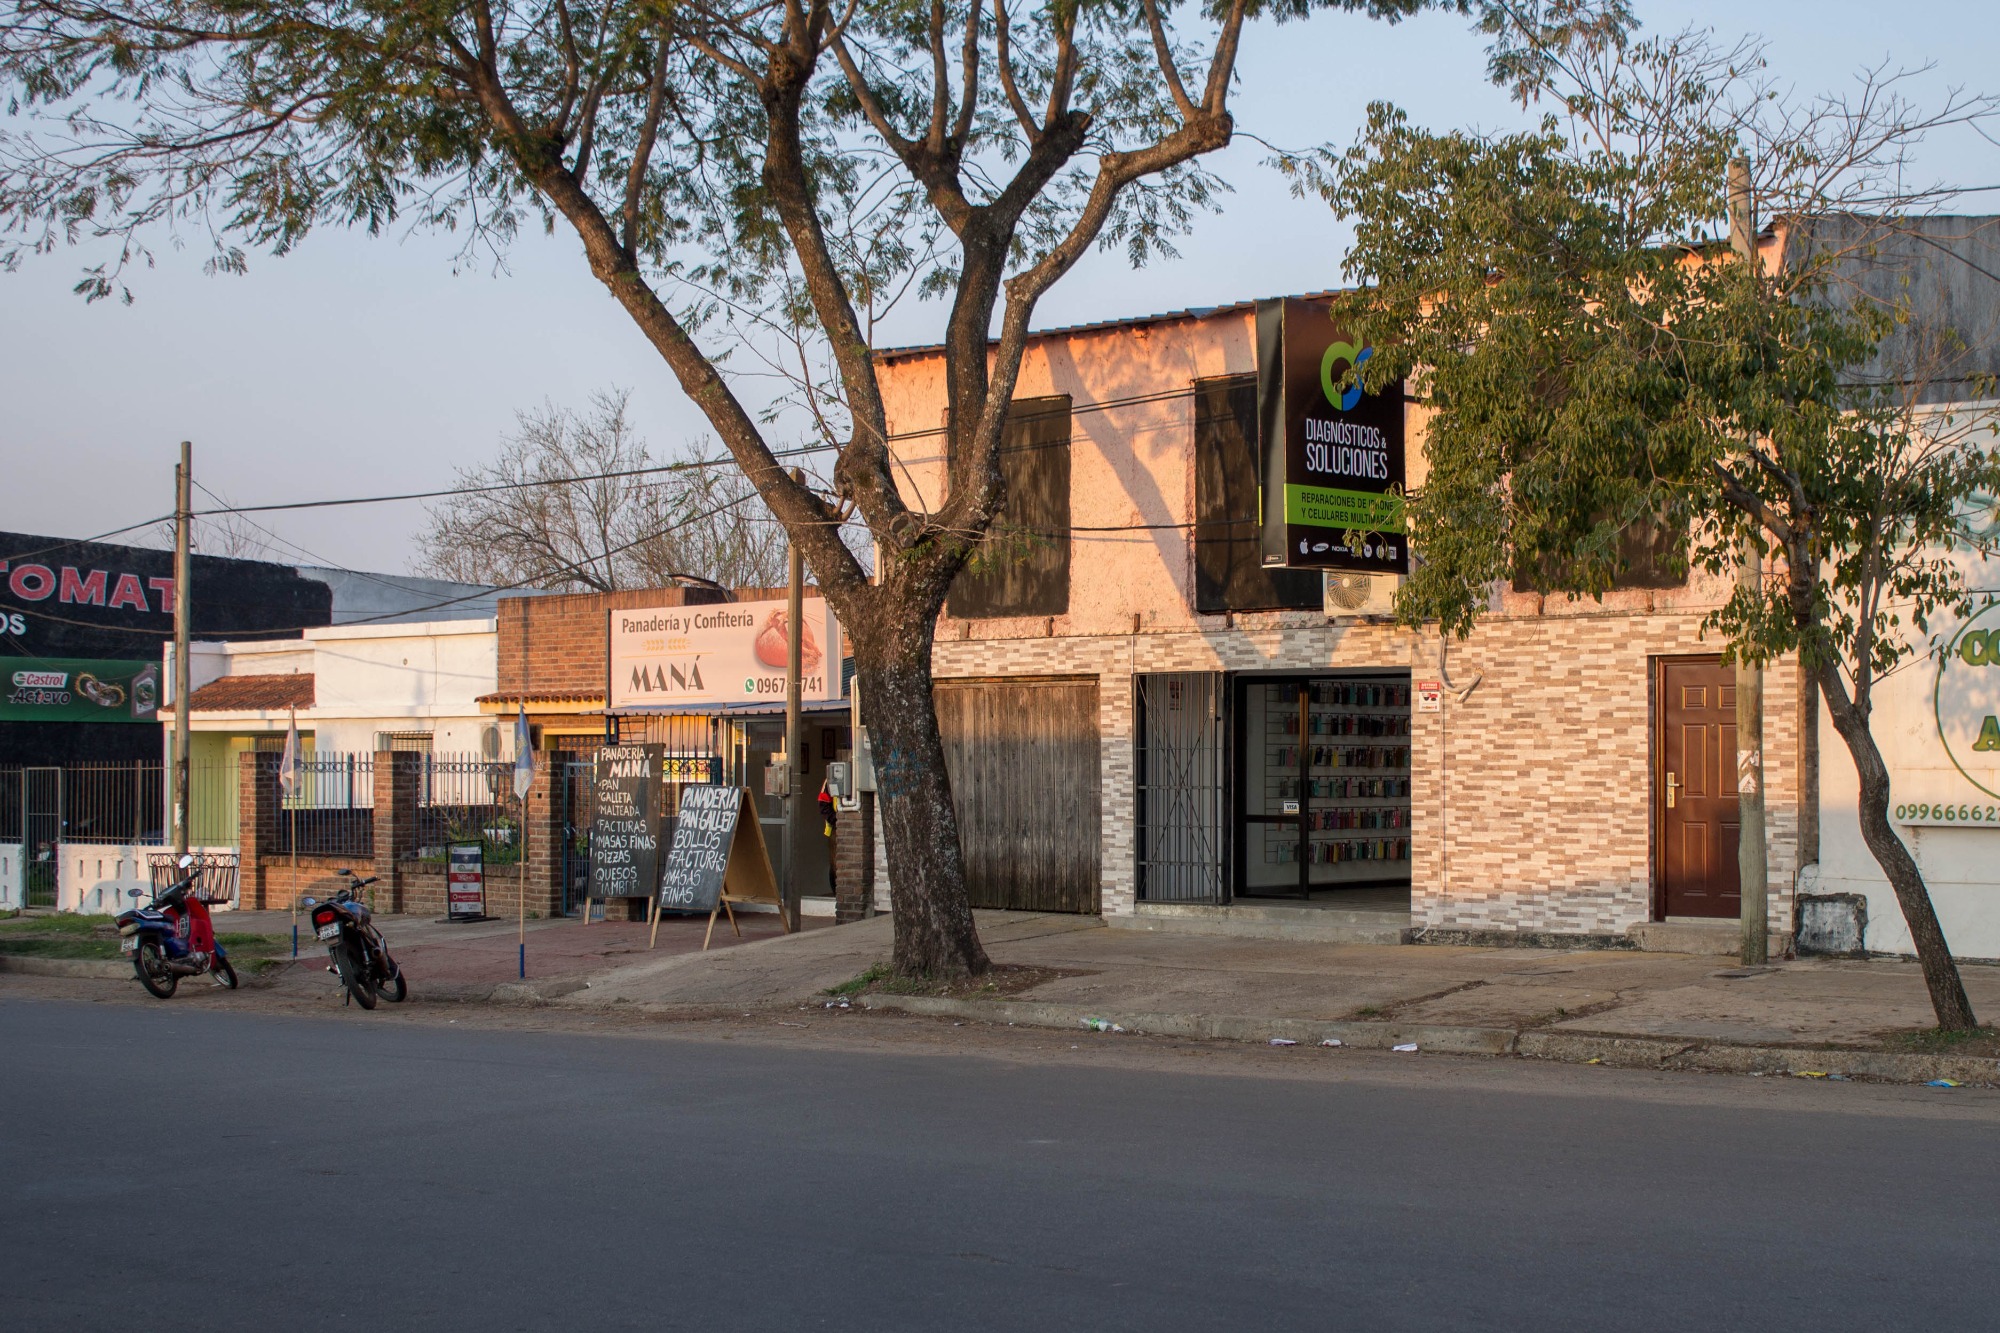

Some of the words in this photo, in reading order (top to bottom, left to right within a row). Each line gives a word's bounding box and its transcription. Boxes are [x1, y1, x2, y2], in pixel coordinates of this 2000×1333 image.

[1305, 418, 1380, 449] DIAGNÓSTICOS
[1381, 437, 1387, 449] &
[1306, 442, 1388, 480] SOLUCIONES
[1301, 492, 1356, 508] REPARACIONES
[1357, 499, 1367, 509] DE
[1301, 507, 1307, 518] Y
[1307, 508, 1349, 523] CELULARES
[1331, 545, 1349, 553] NOKIA
[0, 560, 175, 614] OMAT
[622, 614, 680, 634] Panadería
[683, 616, 691, 634] y
[694, 609, 754, 630] Confitería
[26, 673, 65, 688] Castrol
[628, 654, 705, 694] MANÁ
[757, 676, 823, 694] 0967741
[609, 753, 656, 778] MANÁ
[601, 778, 619, 791] PAN
[600, 791, 633, 805] GALLETA
[600, 804, 641, 817] MALTEADA
[600, 819, 647, 833] FACTURAS
[598, 834, 627, 849] MASAS
[630, 833, 657, 850] FINAS
[674, 829, 721, 850] BOLLOS
[670, 850, 726, 872] FACTURAS
[595, 865, 638, 881] QUESOS
[666, 869, 701, 887] MASAS
[661, 886, 694, 904] FINAS
